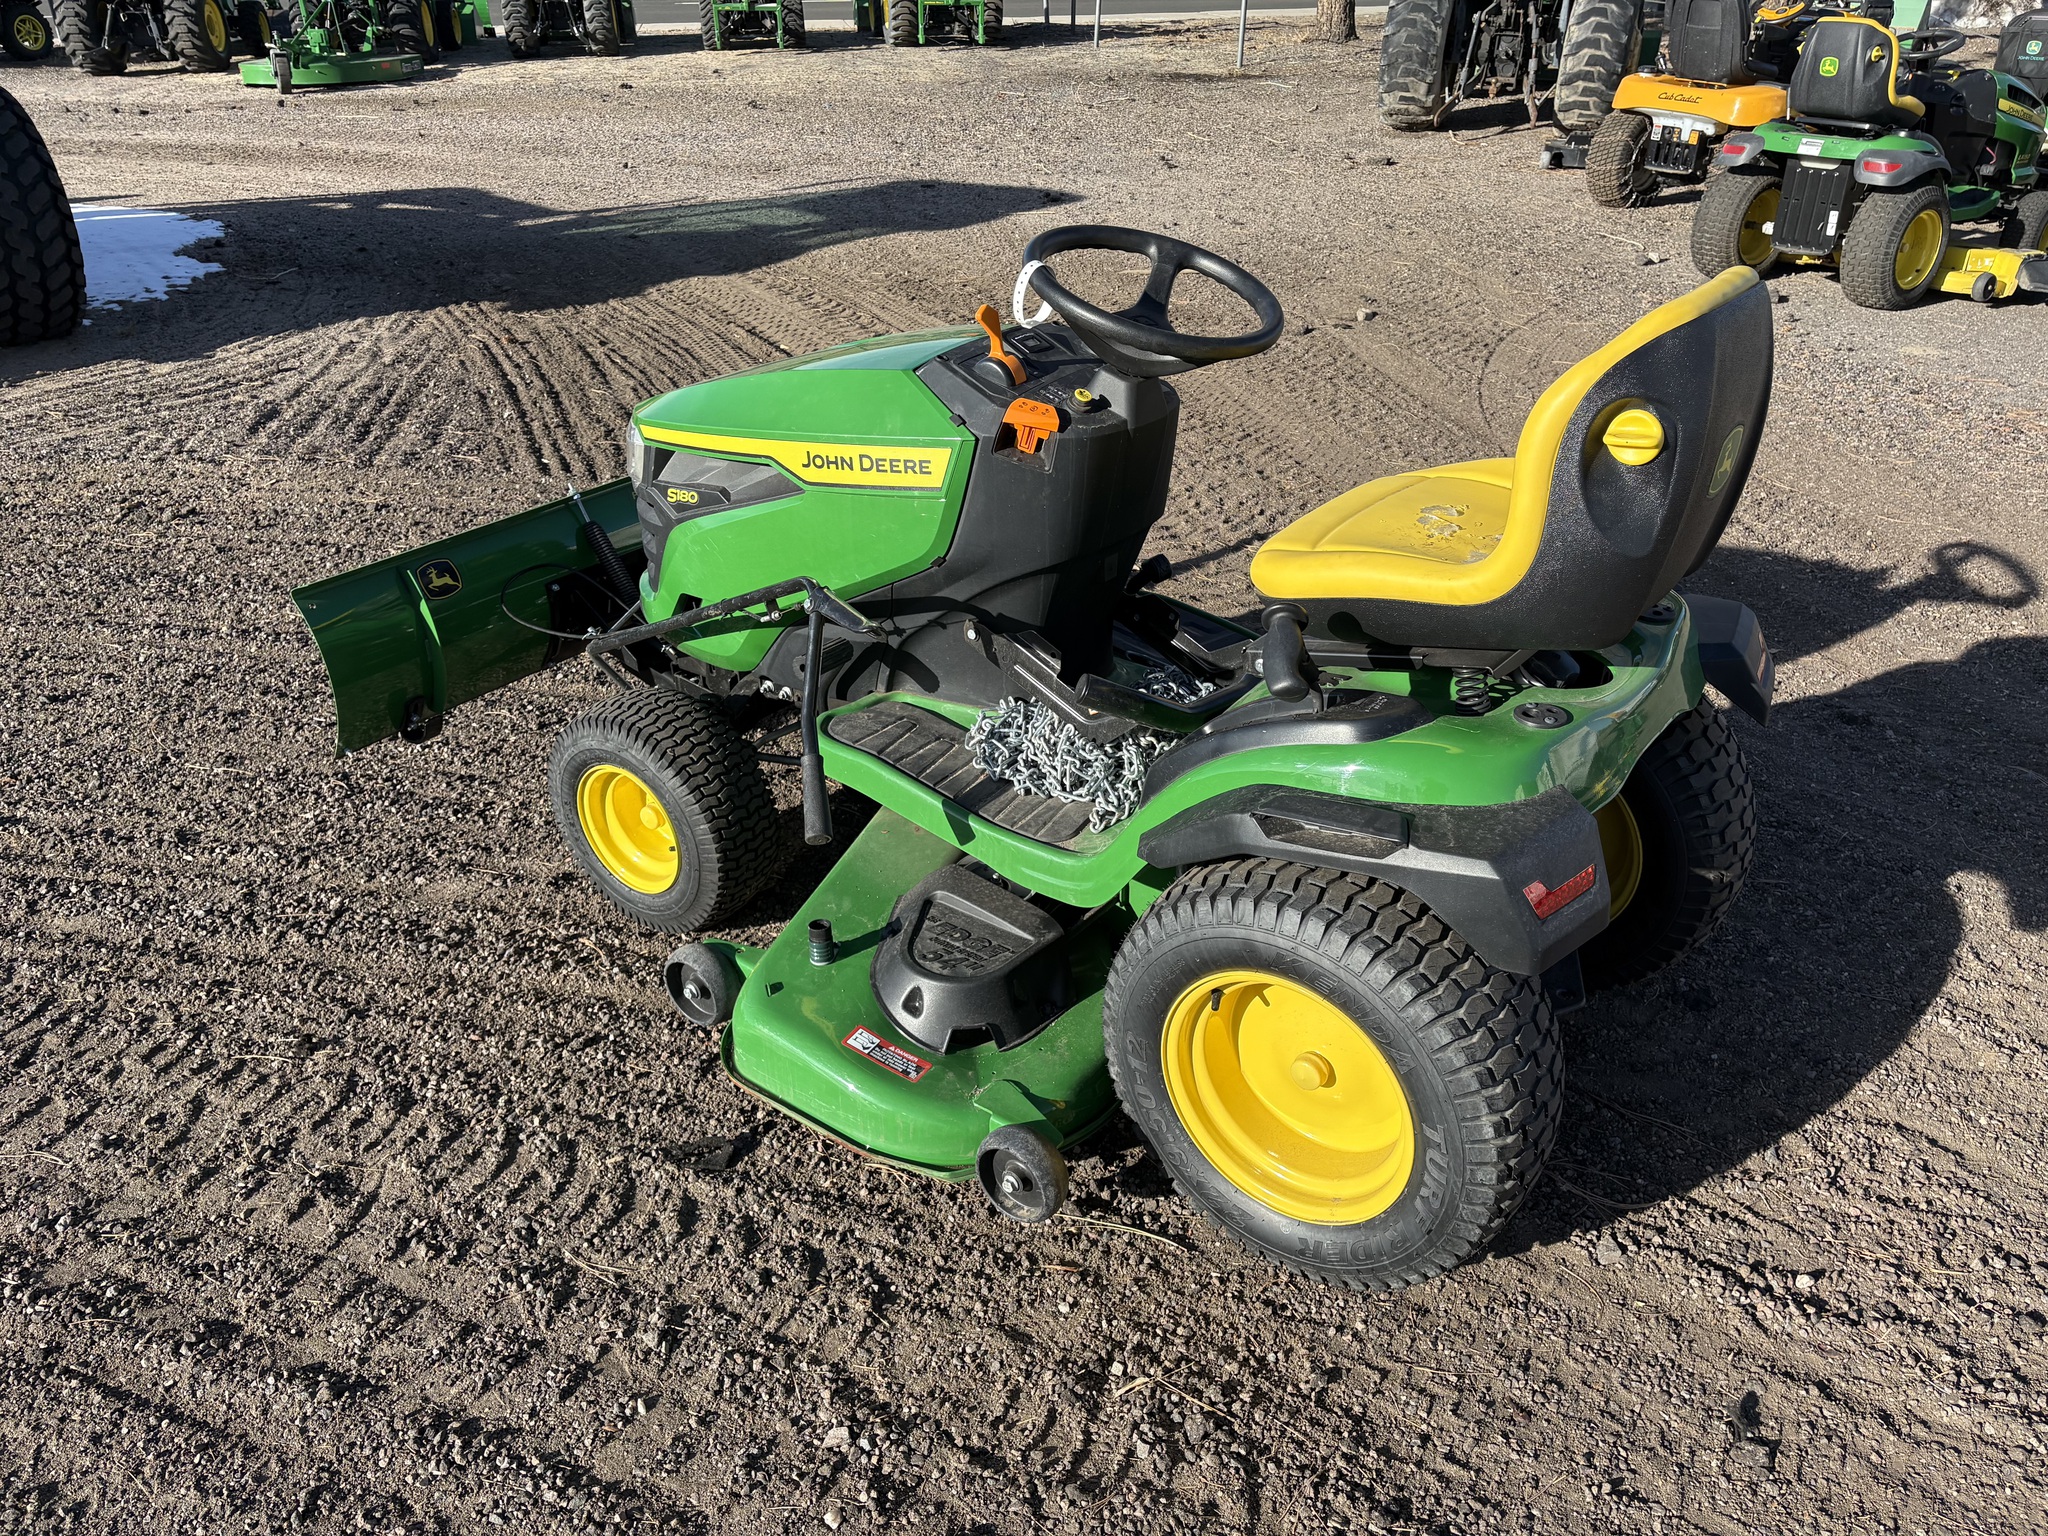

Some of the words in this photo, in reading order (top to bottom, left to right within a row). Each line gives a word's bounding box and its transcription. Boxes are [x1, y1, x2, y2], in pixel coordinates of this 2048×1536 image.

[2006, 105, 2021, 117] JOHN
[802, 450, 854, 472] JOHN
[858, 453, 932, 475] DEERE
[666, 487, 698, 504] S180
[894, 1048, 919, 1062] DANGER
[1414, 1122, 1449, 1236] TURF
[1297, 1220, 1411, 1265] RIDER
